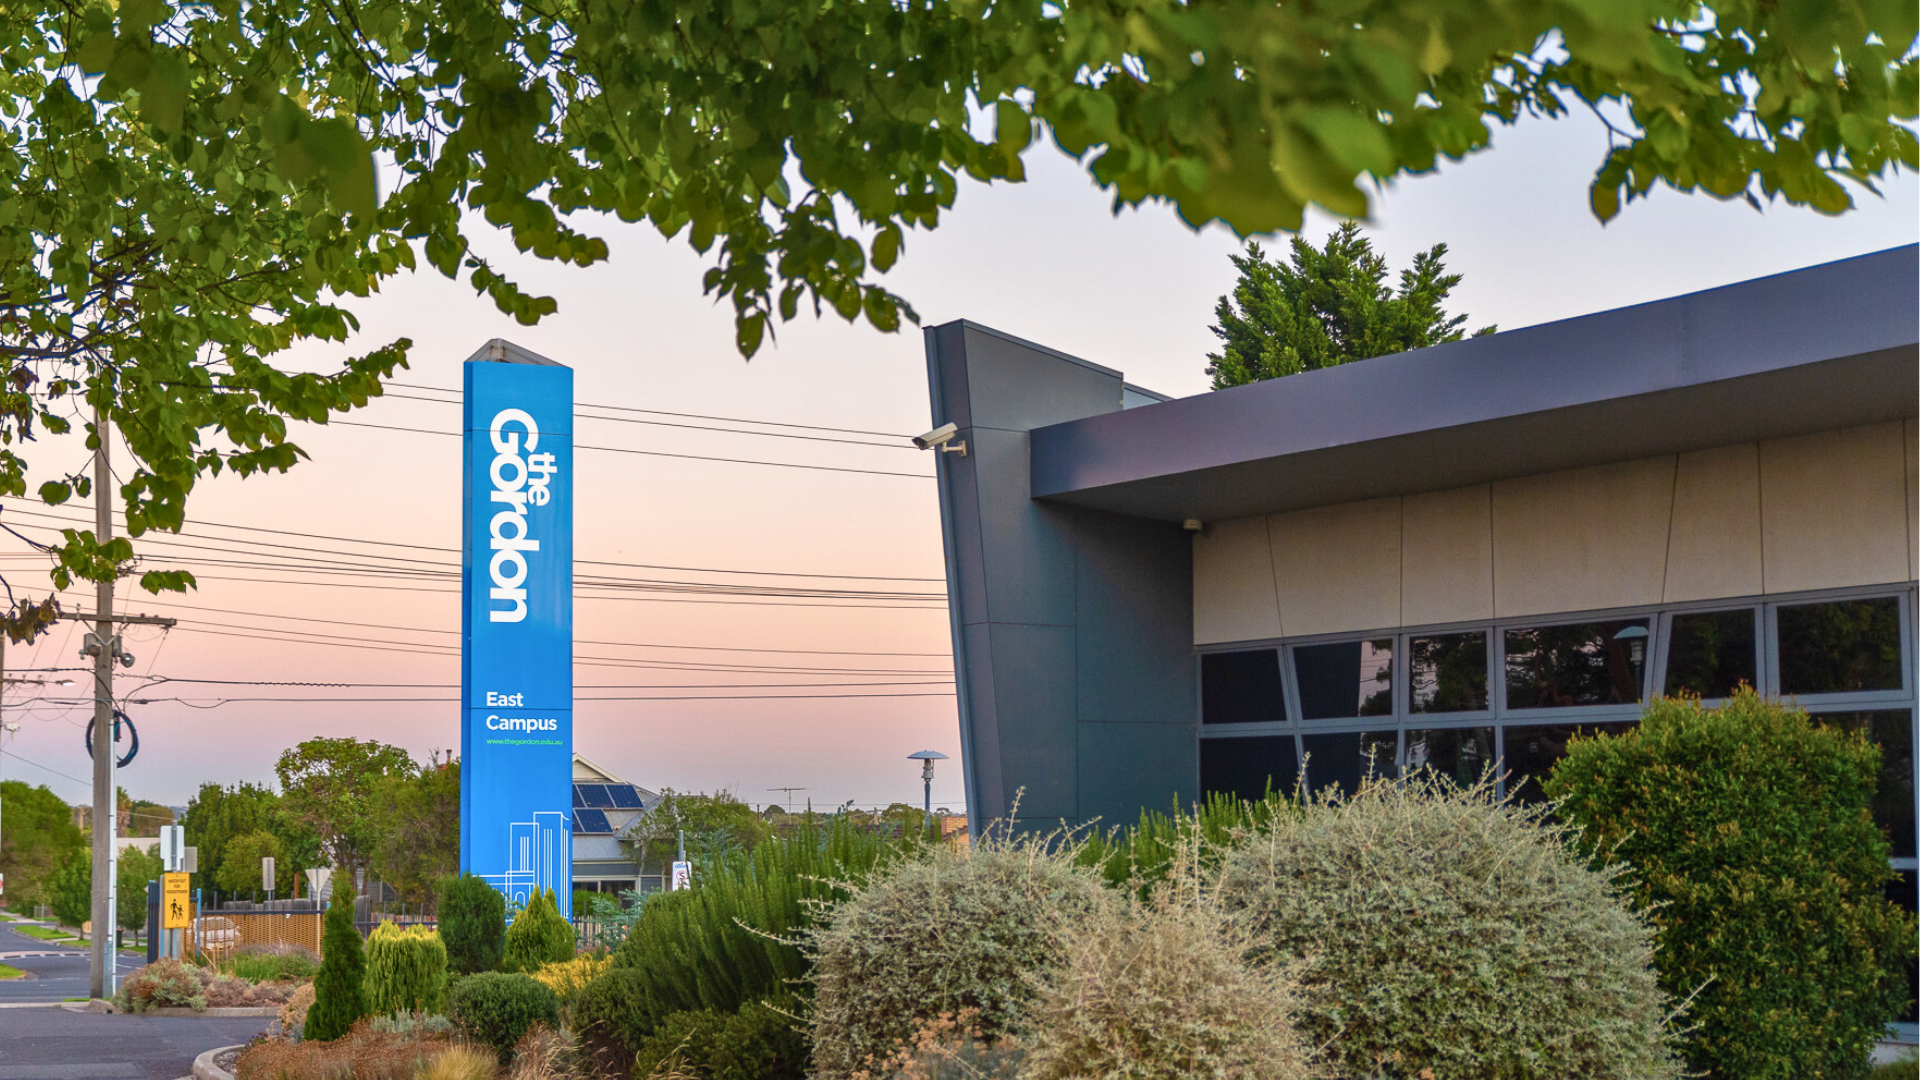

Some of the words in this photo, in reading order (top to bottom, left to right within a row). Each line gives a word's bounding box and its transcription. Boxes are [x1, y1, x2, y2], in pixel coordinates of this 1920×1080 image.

[528, 452, 558, 506] the
[489, 408, 540, 622] Gordon
[486, 691, 524, 707] East
[486, 715, 557, 733] Campus
